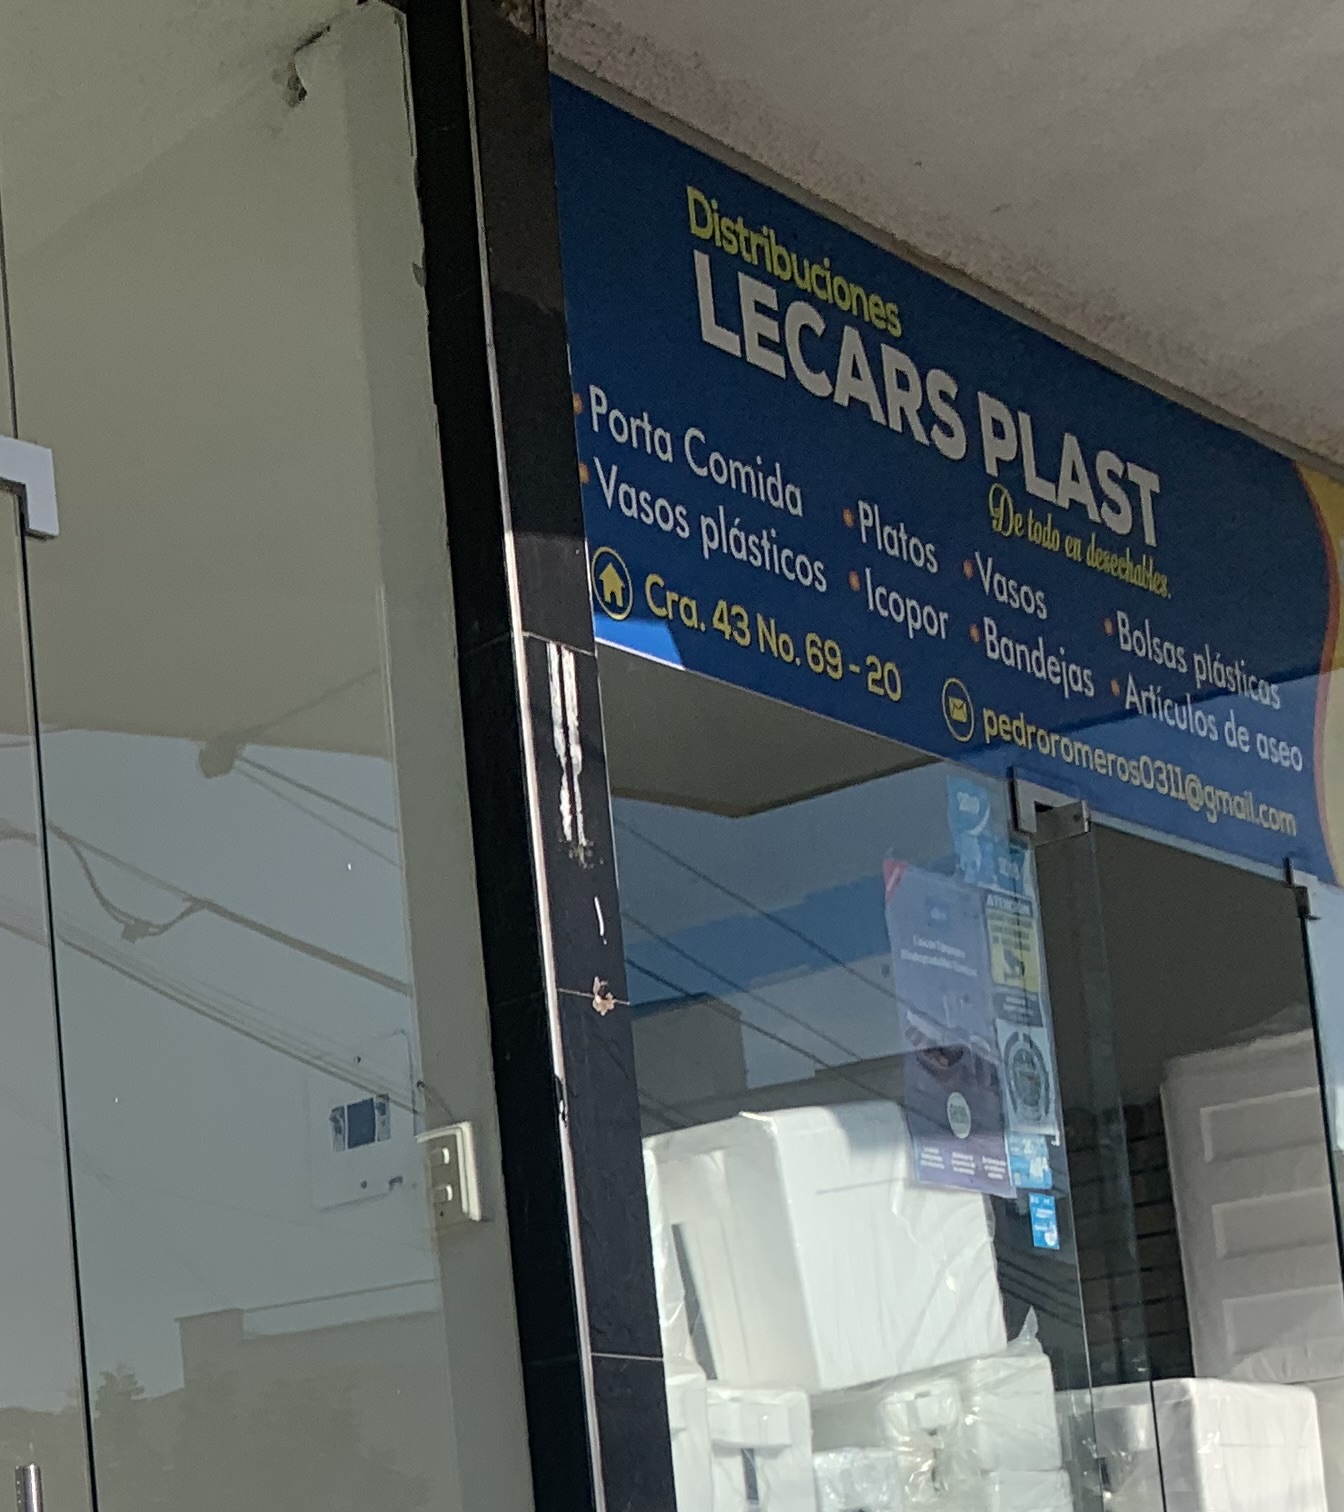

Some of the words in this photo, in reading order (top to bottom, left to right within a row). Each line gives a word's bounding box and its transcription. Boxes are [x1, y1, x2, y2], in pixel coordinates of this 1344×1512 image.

[686, 185, 902, 337] Distribuciones
[694, 249, 967, 460] LECARS
[979, 391, 1161, 547] PLAST
[588, 384, 673, 463] Porta
[684, 427, 803, 517] Comida
[593, 457, 690, 539] Vasos
[700, 505, 828, 593] plásticos
[858, 499, 938, 574] Platos
[988, 483, 1023, 537] De
[1027, 512, 1061, 552] todo
[1065, 539, 1082, 563] en
[865, 567, 949, 640] Icopor
[974, 551, 1048, 620] Vasos
[645, 574, 706, 632] Cra.
[712, 600, 751, 648] 43
[757, 613, 802, 666] No.
[805, 632, 843, 680] 69
[849, 662, 861, 674] -
[866, 655, 902, 702] 20
[983, 616, 1095, 699] Bandejas
[1117, 610, 1188, 674] Bolsas
[1193, 643, 1281, 710] plásticas
[983, 705, 1297, 837] pedroromeros0311@gmail.com
[1124, 672, 1218, 742] Artículos
[1224, 710, 1250, 752] de
[1256, 735, 1303, 772] aseo
